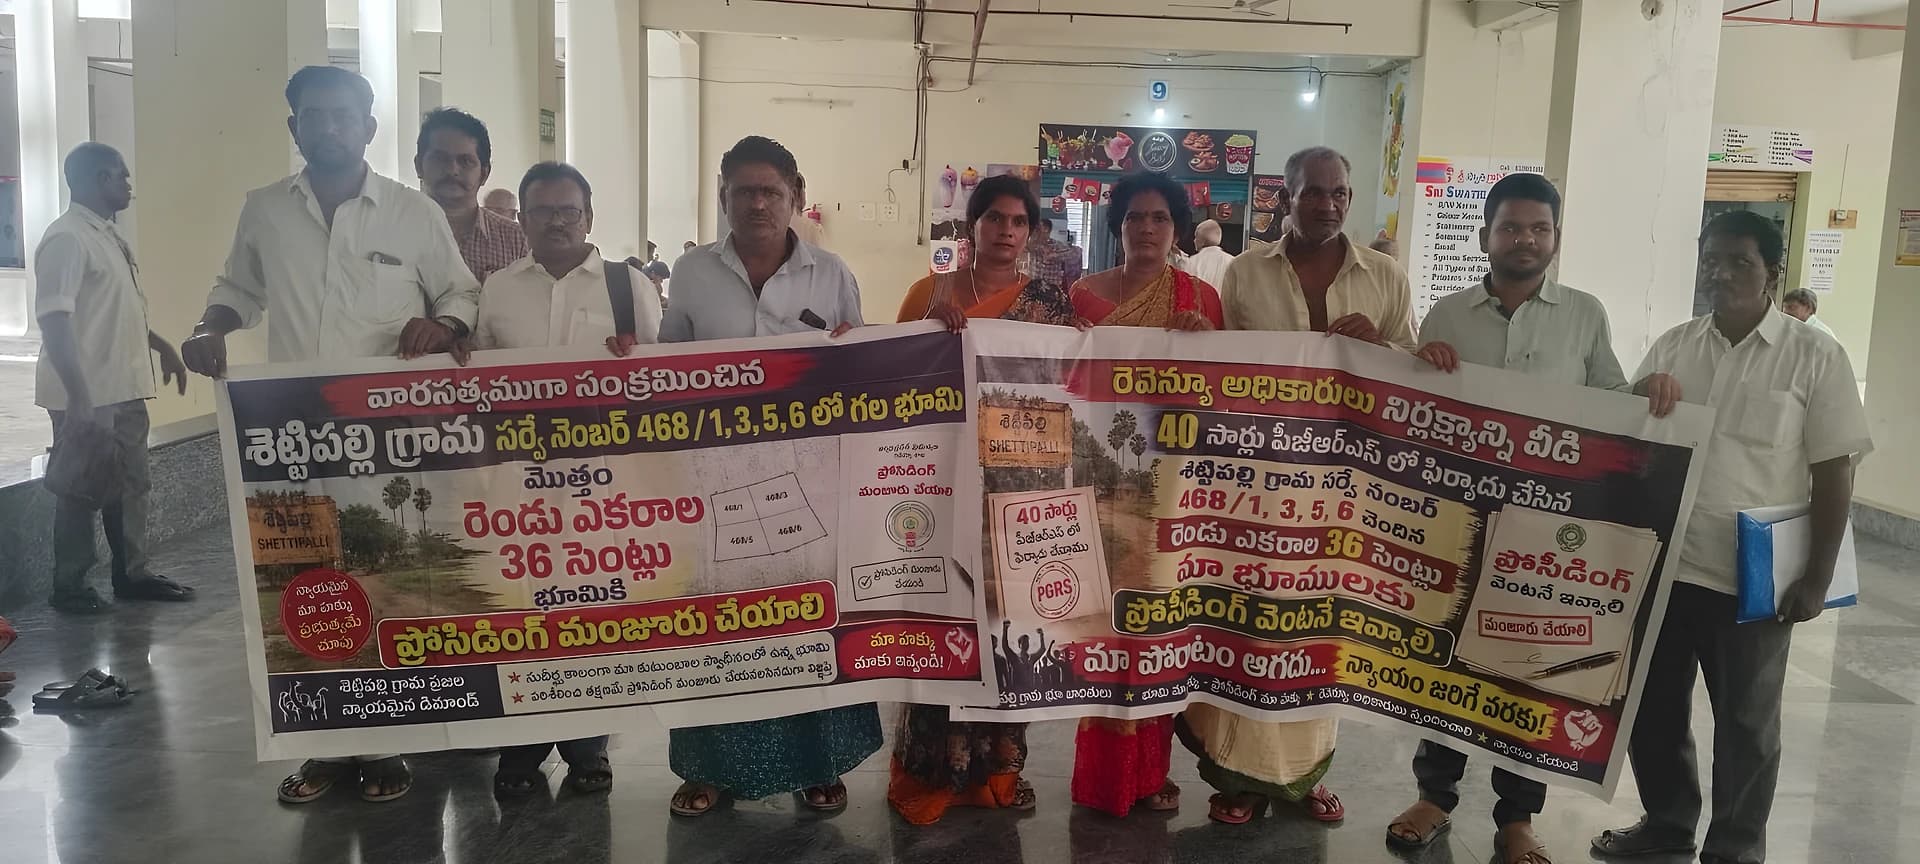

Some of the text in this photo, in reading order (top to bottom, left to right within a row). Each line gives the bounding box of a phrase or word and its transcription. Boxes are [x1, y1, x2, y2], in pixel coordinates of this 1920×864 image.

[1152, 82, 1167, 99] 9
[367, 358, 765, 412] వారసత్వముగా సంక్రమించిన
[245, 419, 376, 481] శెట్టిపల్లి
[384, 414, 484, 467] గ్రామ
[495, 413, 547, 462] సర్వే
[551, 410, 630, 449] నెంబర్
[811, 390, 844, 428] లో
[850, 392, 888, 423] గల
[894, 386, 964, 424] భూమి
[1112, 366, 1582, 465] రెవెన్యూ అధికారులు నిర్లక్ష్యాన్ని వీడి
[523, 464, 612, 498] మొత్తం
[1156, 413, 1573, 512] 40 సార్లు పీజీఆర్ఎస్ లో ఫిర్యాదు చేసిన
[1178, 459, 1257, 489] శెట్టిపల్లి
[1264, 467, 1315, 491] గ్రామ
[1321, 469, 1359, 499] సర్వే
[463, 494, 705, 541] రెండు ఎకరాల
[1016, 500, 1078, 525] 40 సార్లు
[1279, 498, 1307, 523] 3,
[1310, 500, 1331, 523] 5,
[1336, 502, 1356, 522] 6
[1361, 509, 1426, 545] చెందిన
[257, 535, 329, 550] SHETTIPALLI
[500, 537, 672, 582] 36 సెంట్లు
[1170, 520, 1442, 591] రెండు ఎకరాల 36 సెంట్లు
[1037, 578, 1073, 602] PGRS
[1177, 553, 1416, 611] మా భూములకు
[1493, 549, 1635, 594] ప్రోసీడింగ్
[534, 578, 628, 610] భూమికి
[1490, 574, 1625, 616] వెంటనే ఇవ్వాలి
[393, 592, 825, 666] ప్రోసిడింగ్ మంజూరు చేయాలి
[1254, 601, 1334, 635] వెంటనే
[1543, 620, 1587, 637] చేయాలి
[870, 632, 895, 648] మా
[1083, 643, 1130, 673] మా
[1138, 635, 1236, 675] పోరాటం
[854, 655, 891, 671] మాకు
[391, 677, 425, 694] గ్రామ
[419, 692, 480, 711] డిమాండ్
[1345, 653, 1546, 736] న్యాయం జరిగే వరకు!
